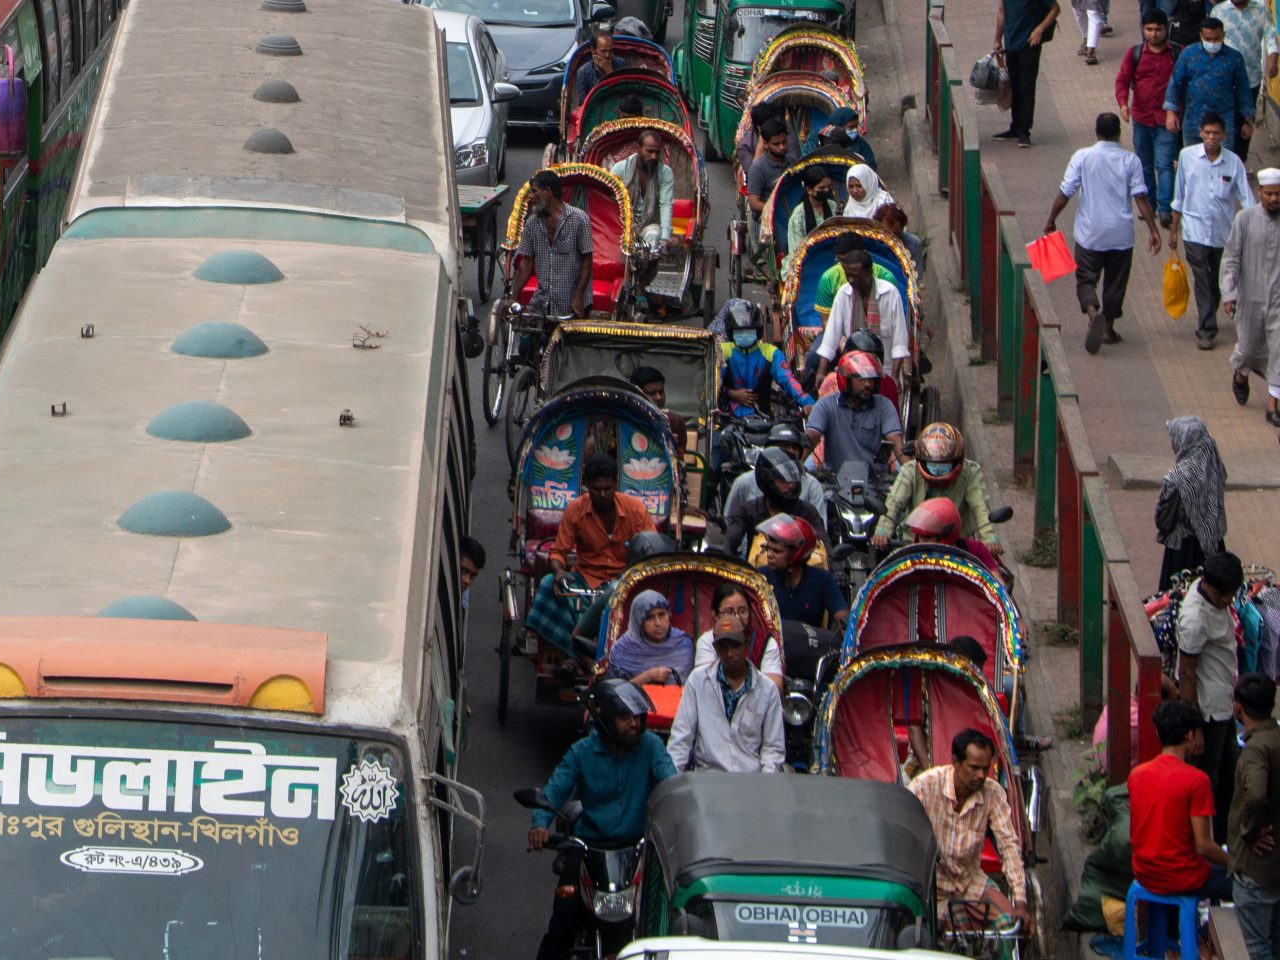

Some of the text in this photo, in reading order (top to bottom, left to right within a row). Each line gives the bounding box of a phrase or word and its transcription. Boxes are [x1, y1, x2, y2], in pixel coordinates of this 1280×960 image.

[738, 9, 764, 17] OBHAI
[74, 811, 299, 848] গুলিস্থান-খিলগাঁও
[83, 851, 184, 872] রুট নং-এ/৪৩৯
[738, 906, 796, 922] OBHAI
[805, 908, 865, 924] OBHAI
